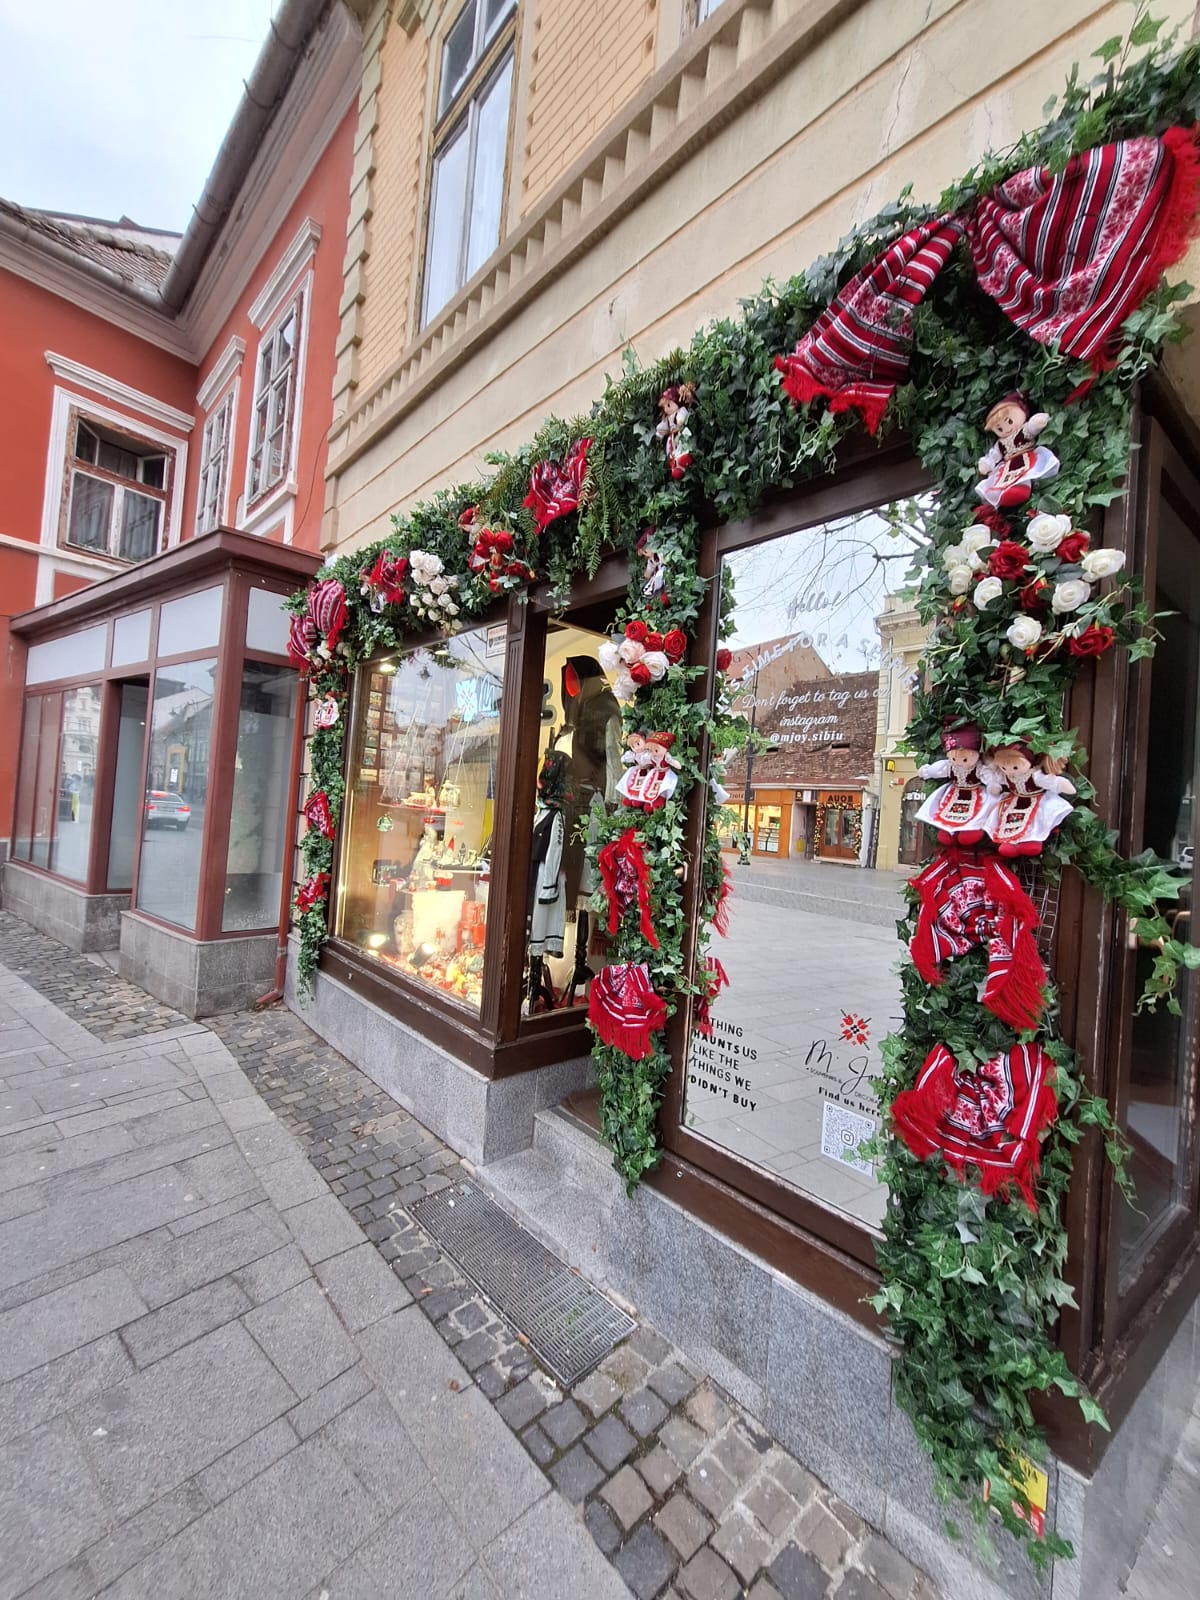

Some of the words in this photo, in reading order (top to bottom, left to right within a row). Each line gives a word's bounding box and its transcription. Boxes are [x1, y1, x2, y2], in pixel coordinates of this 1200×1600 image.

[775, 688, 812, 711] forget
[813, 688, 825, 702] to
[829, 688, 851, 709] tag
[854, 688, 869, 699] us
[770, 728, 844, 743] @mjoy.sibiu
[779, 714, 838, 733] instagram
[692, 1043, 715, 1061] LIKE
[718, 1053, 740, 1071] THE
[693, 1029, 740, 1055] HAUNTS
[742, 1046, 757, 1061] US
[692, 1057, 732, 1082] THINGS
[734, 1075, 752, 1092] WE
[690, 1074, 728, 1099] DIDN'T
[732, 1093, 757, 1112] BUY
[818, 1086, 840, 1102] Find
[843, 1098, 855, 1107] us
